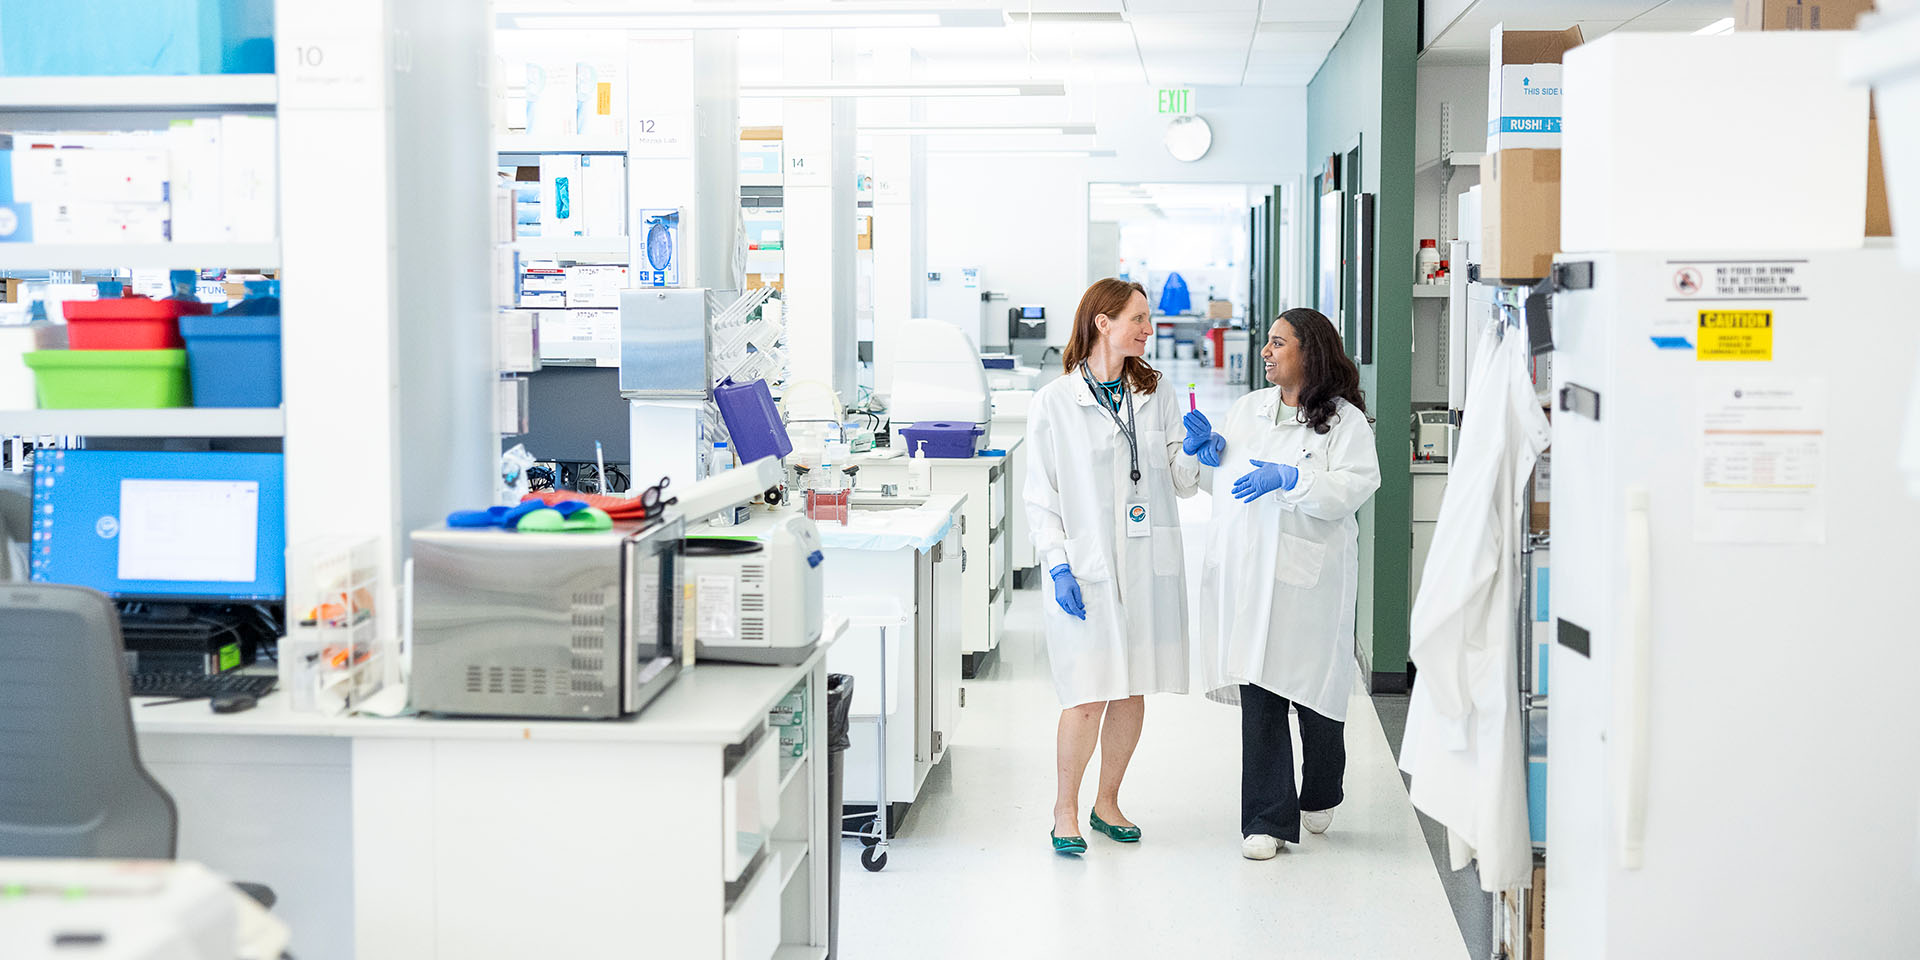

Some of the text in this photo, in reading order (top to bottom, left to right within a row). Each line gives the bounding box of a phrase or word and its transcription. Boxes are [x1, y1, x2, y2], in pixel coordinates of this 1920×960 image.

[296, 46, 323, 67] 10
[1524, 87, 1540, 96] THIS
[1541, 87, 1558, 96] SIDE
[1158, 89, 1190, 113] EXIT
[639, 119, 656, 133] 12
[1510, 119, 1543, 131] RUSH!
[792, 157, 804, 168] 14
[1731, 267, 1752, 275] FOOD
[1738, 286, 1801, 294] REFRIGERATOR
[1704, 313, 1767, 328] CAUTION
[771, 705, 793, 714] TECH
